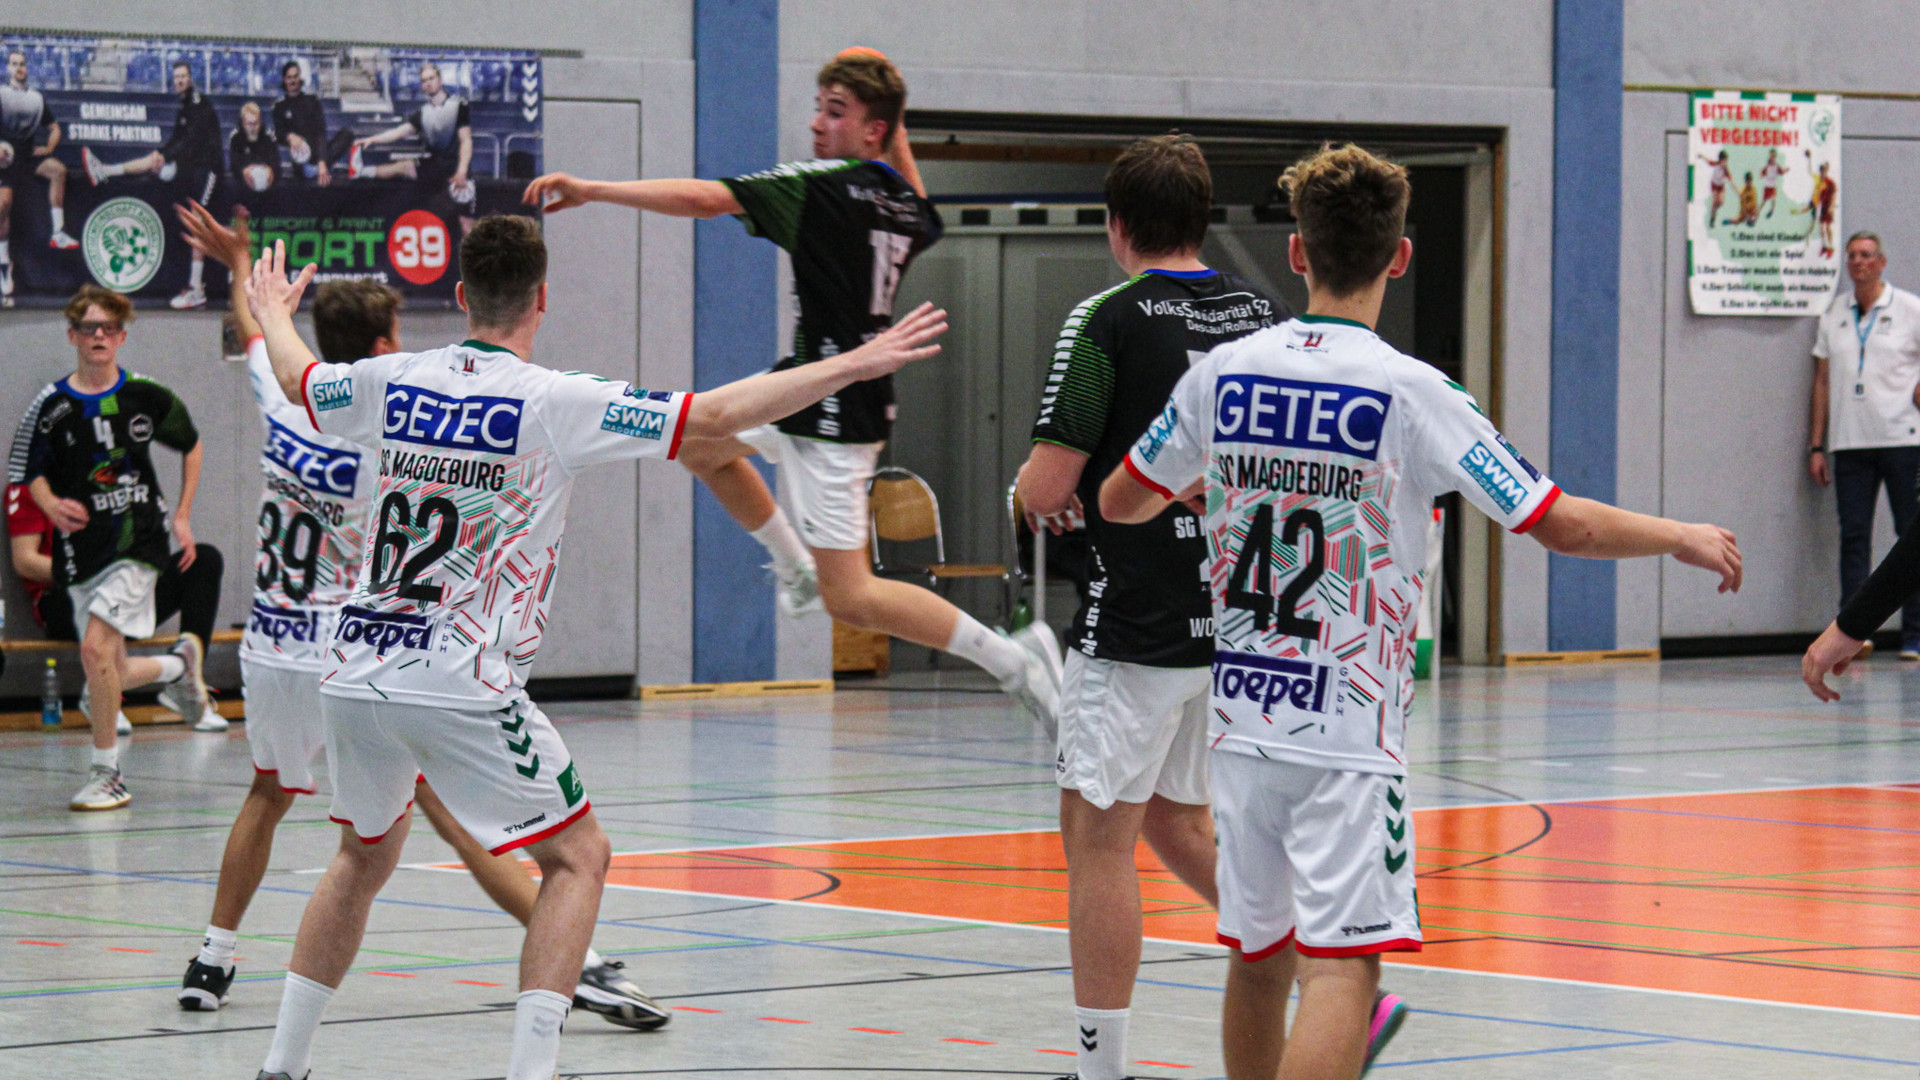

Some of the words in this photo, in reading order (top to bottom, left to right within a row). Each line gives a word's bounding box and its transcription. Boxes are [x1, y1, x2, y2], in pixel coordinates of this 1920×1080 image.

[81, 102, 147, 121] GEMEINSAM
[1701, 103, 1743, 121] BITTE
[1748, 105, 1798, 123] NICHT
[112, 125, 162, 142] PARTNER
[1700, 127, 1799, 147] VERGESSEN!
[394, 225, 446, 268] 39
[314, 380, 352, 402] SWM
[93, 415, 115, 450] 4
[383, 390, 519, 450] GETEC
[604, 404, 663, 431] SWM
[1216, 381, 1386, 452] GETEC
[392, 450, 505, 492] MAGDEBURG
[1238, 454, 1364, 503] MAGDEBURG
[1468, 444, 1525, 506] SWM
[368, 491, 459, 602] 62
[1174, 516, 1197, 539] SG
[256, 501, 322, 601] 39
[1225, 504, 1325, 641] 42
[513, 812, 547, 832] hummel
